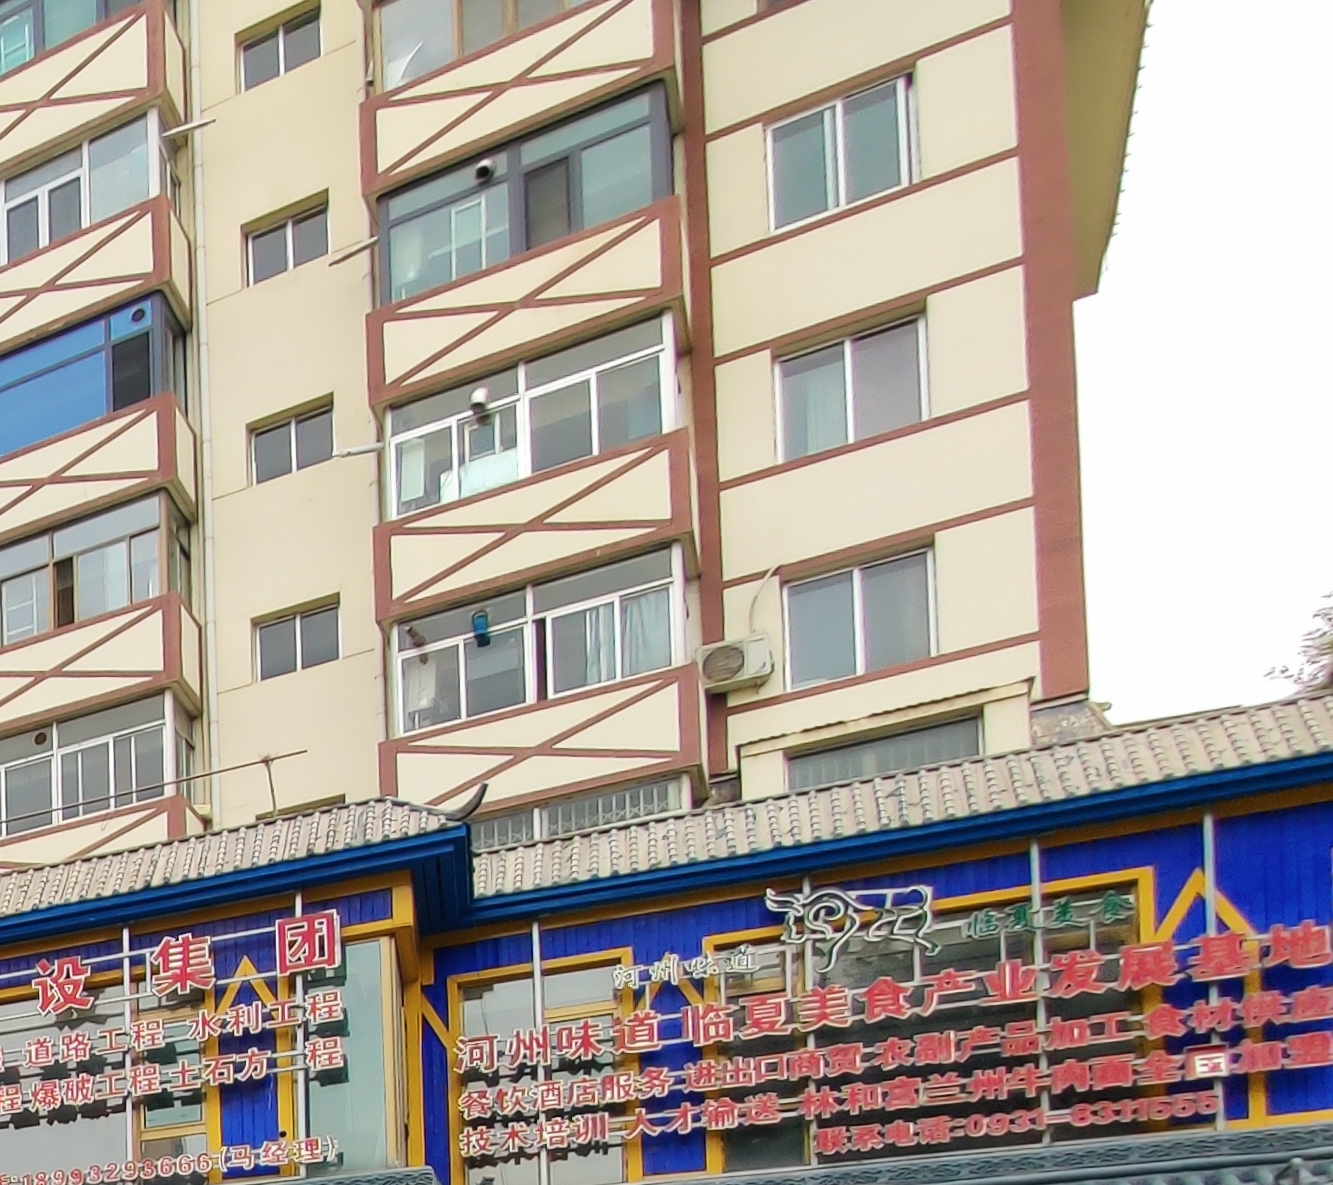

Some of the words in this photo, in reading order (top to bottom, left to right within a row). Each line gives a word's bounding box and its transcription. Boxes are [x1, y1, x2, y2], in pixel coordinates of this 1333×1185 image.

[961, 888, 1135, 940] 临夏美食
[612, 943, 763, 990] 河州味道
[20, 1018, 166, 1068] 道路工程
[187, 991, 344, 1042] 水利工程
[30, 1062, 162, 1110] 爆破工程
[459, 1065, 674, 1120] 餐饮酒店服务
[683, 1039, 863, 1093] 进出口商贸
[874, 1010, 1133, 1071] 农副产品加工
[459, 1111, 611, 1157] 技术培训
[623, 1092, 782, 1140] 人才输送
